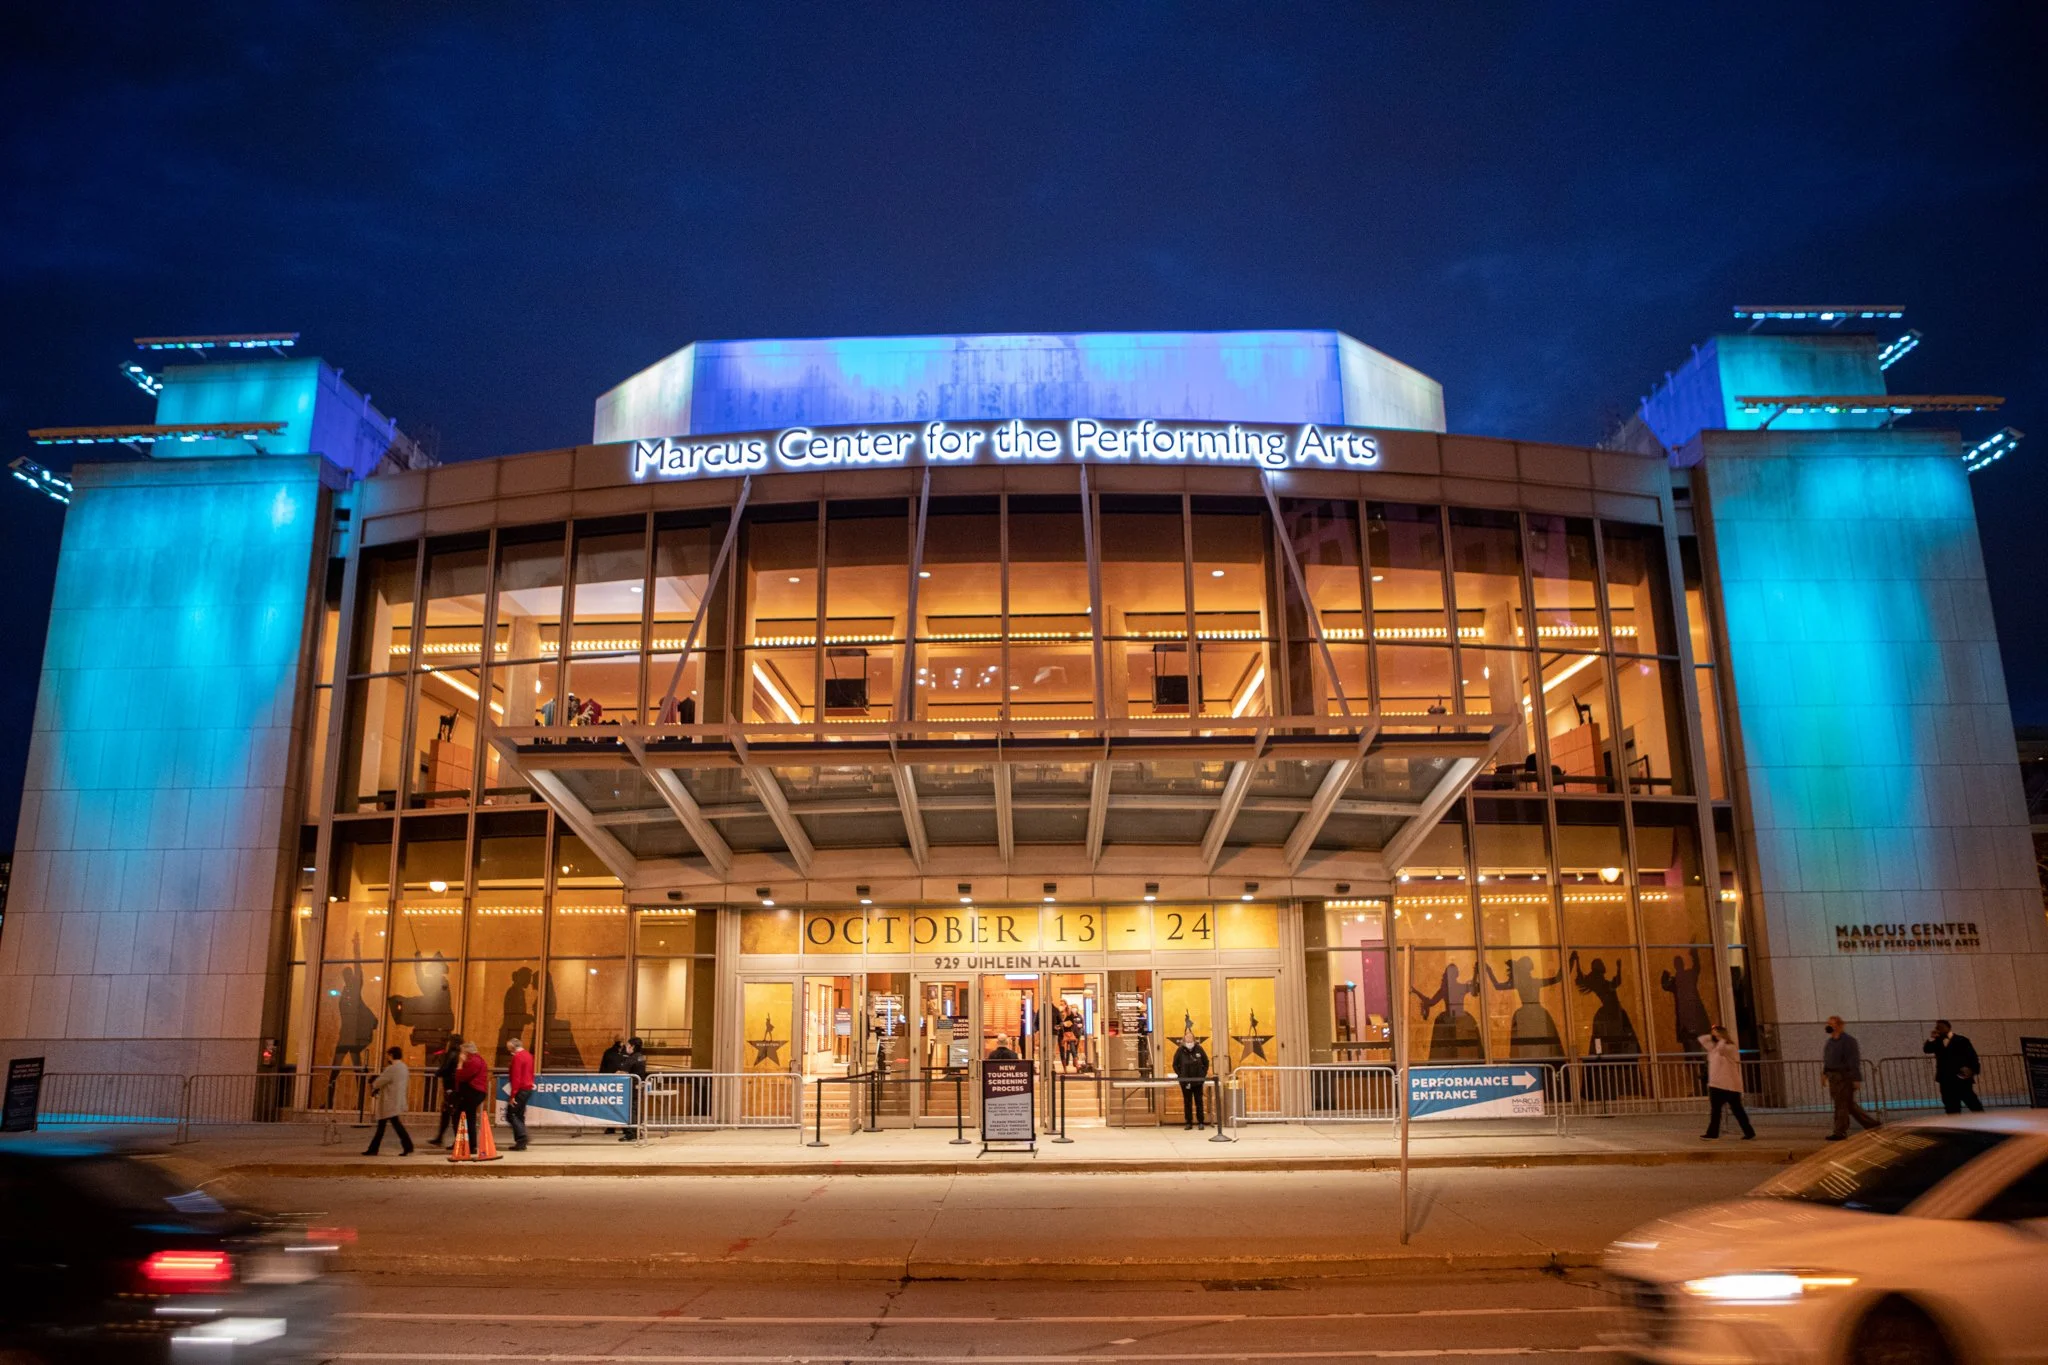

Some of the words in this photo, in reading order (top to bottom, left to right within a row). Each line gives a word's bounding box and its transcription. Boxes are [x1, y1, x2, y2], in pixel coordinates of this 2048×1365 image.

[633, 437, 764, 473] Marcus
[777, 427, 913, 461] Center
[925, 423, 982, 459] for
[994, 420, 1058, 455] the
[1074, 420, 1288, 464] Performing
[1295, 425, 1378, 463] Arts
[807, 916, 1022, 944] OCTOBER
[1055, 914, 1095, 942] 13
[1167, 913, 1212, 941] 24
[1836, 924, 1906, 937] MARCUS
[1911, 923, 1979, 936] CENTER
[1838, 940, 1857, 949] FOR
[1861, 940, 1881, 949] THE
[1885, 939, 1951, 948] PERFORMING
[1955, 938, 1980, 947] ARTS
[934, 957, 960, 969] 929
[967, 957, 1032, 969] UIHLEIN
[1038, 956, 1081, 968] HALL
[532, 1083, 624, 1093] PERFORMANCE
[1411, 1076, 1509, 1088] PERFORMANCE
[561, 1096, 624, 1105] ENTRANCE
[1412, 1090, 1478, 1101] ENTRANCE
